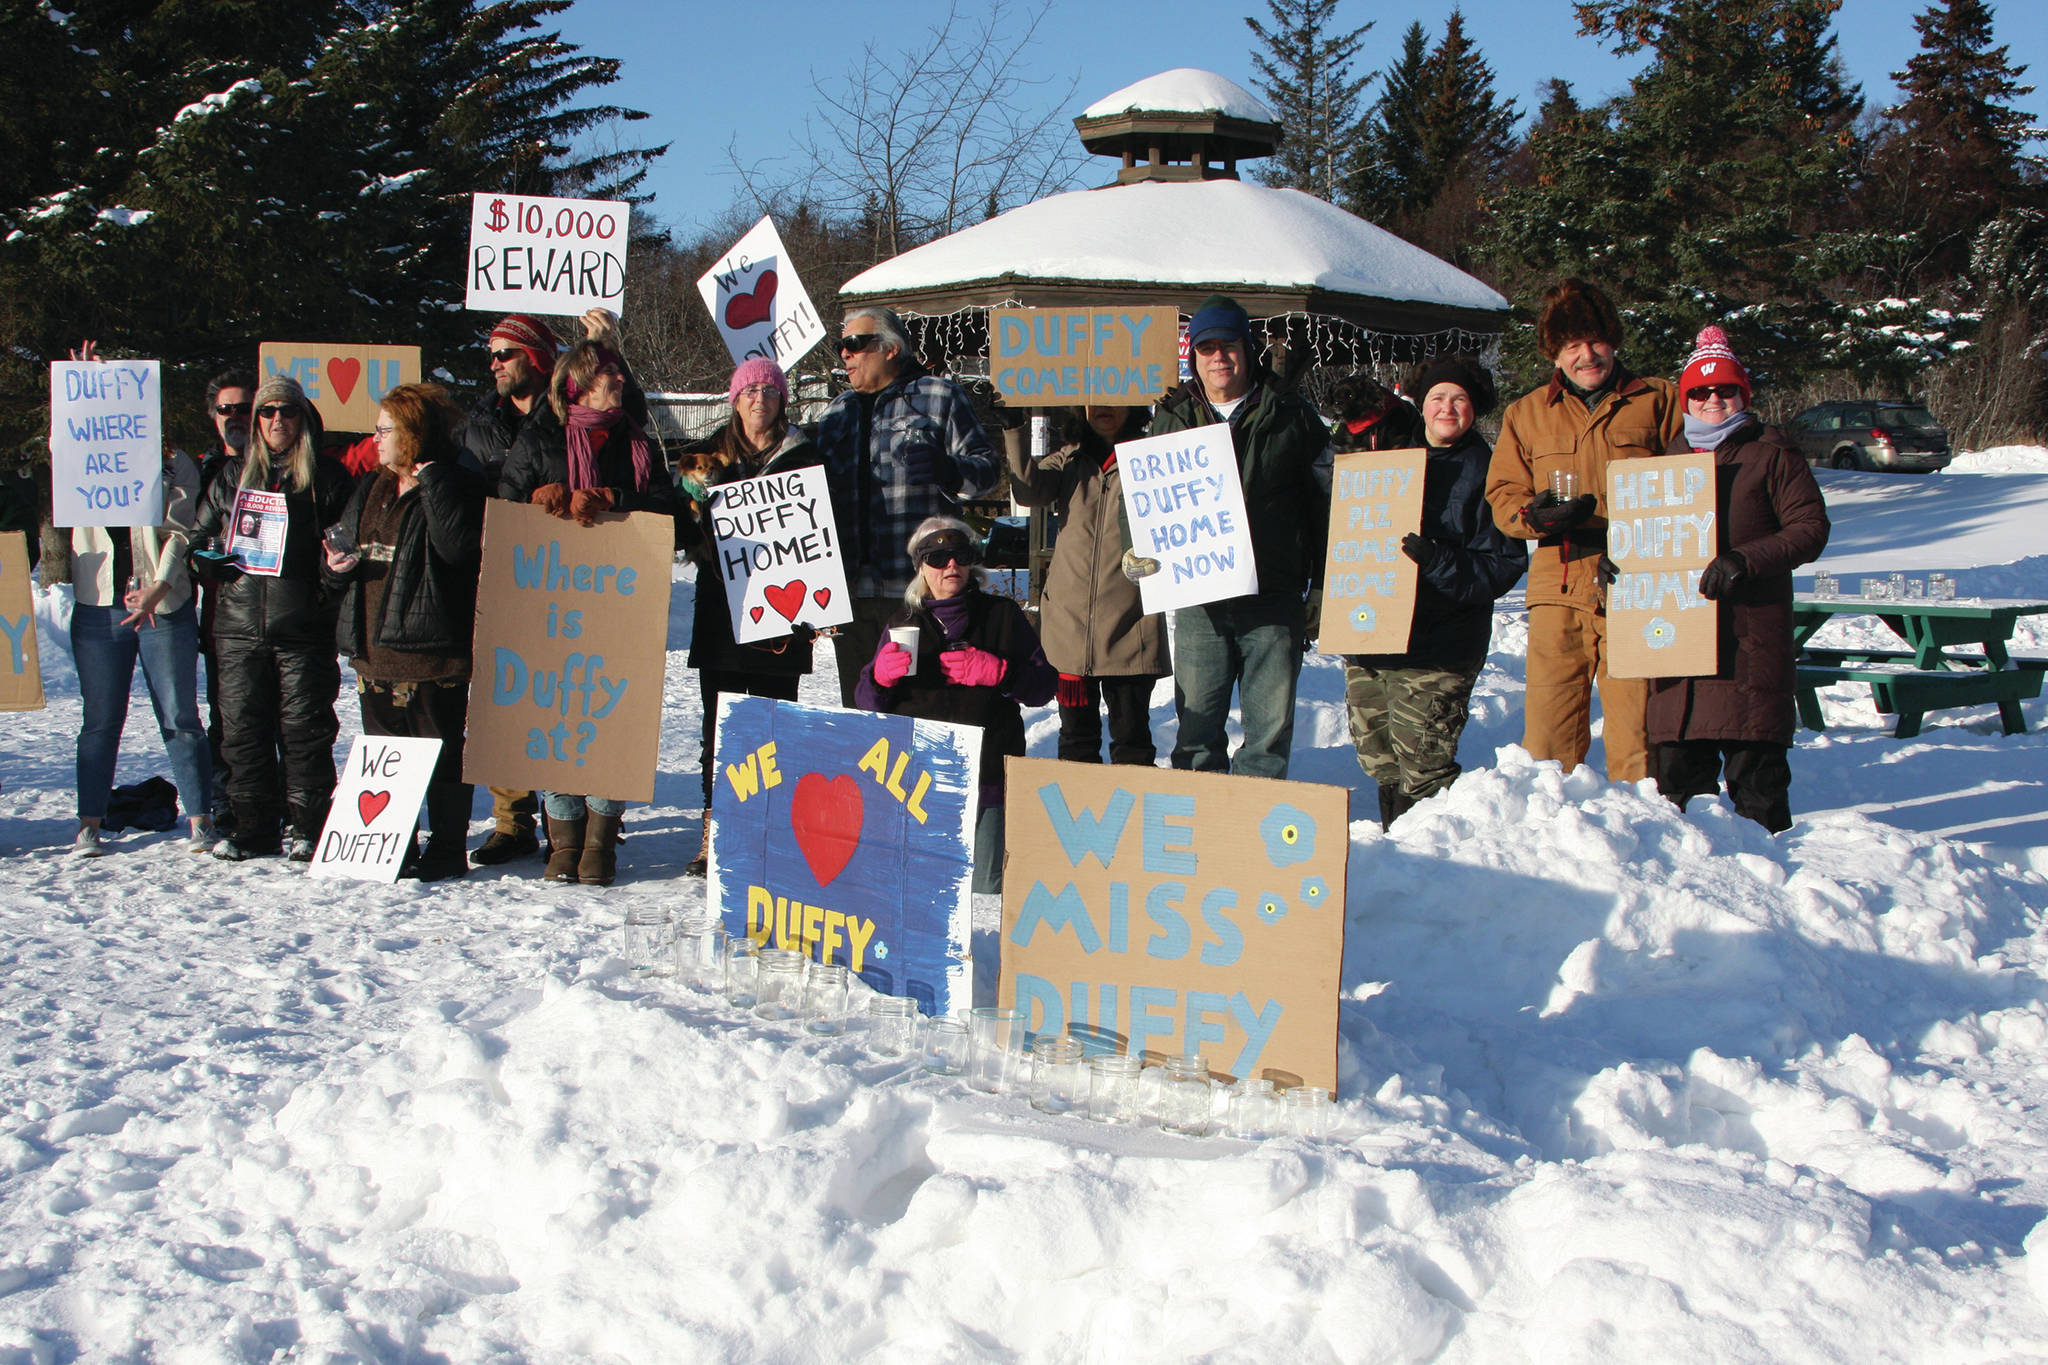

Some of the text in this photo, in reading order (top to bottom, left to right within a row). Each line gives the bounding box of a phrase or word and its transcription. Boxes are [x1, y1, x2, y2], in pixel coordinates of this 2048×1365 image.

[484, 199, 616, 239] $10,000
[474, 245, 625, 298] REWARD
[713, 255, 753, 294] We
[999, 313, 1153, 358] DUFFY
[65, 367, 149, 401] DUFFY
[264, 356, 320, 399] WE
[997, 363, 1163, 396] COME HOME
[1700, 361, 1717, 376] W
[67, 413, 148, 442] WHERE
[85, 451, 129, 475] ARE
[1129, 444, 1210, 482] BRING
[76, 480, 144, 509] YOU?
[240, 493, 287, 506] ABDUCTE
[724, 473, 806, 510] BRING
[1132, 472, 1224, 518] DUFFY
[1338, 467, 1415, 500] DUFFY
[1614, 466, 1707, 510] HELP
[714, 498, 819, 542] DUFFY
[1150, 509, 1235, 553] HOME
[1349, 503, 1392, 530] PLZ
[1610, 510, 1715, 561] DUFFY
[513, 540, 638, 596] Where
[724, 527, 833, 581] HOME!
[1172, 545, 1235, 584] NOW
[1332, 536, 1399, 563] COME
[1329, 571, 1396, 599] HOME
[1611, 569, 1708, 611] HOME
[547, 602, 583, 639] is
[492, 647, 629, 719] Duffy
[361, 744, 402, 778] We
[526, 720, 597, 767] at?
[725, 736, 932, 825] WE ALL
[321, 830, 401, 865] DUFFY!
[1037, 781, 1198, 876] WE
[746, 885, 876, 973] DUFFY
[1009, 879, 1244, 967] MISS
[1015, 973, 1284, 1080] DUFFY
